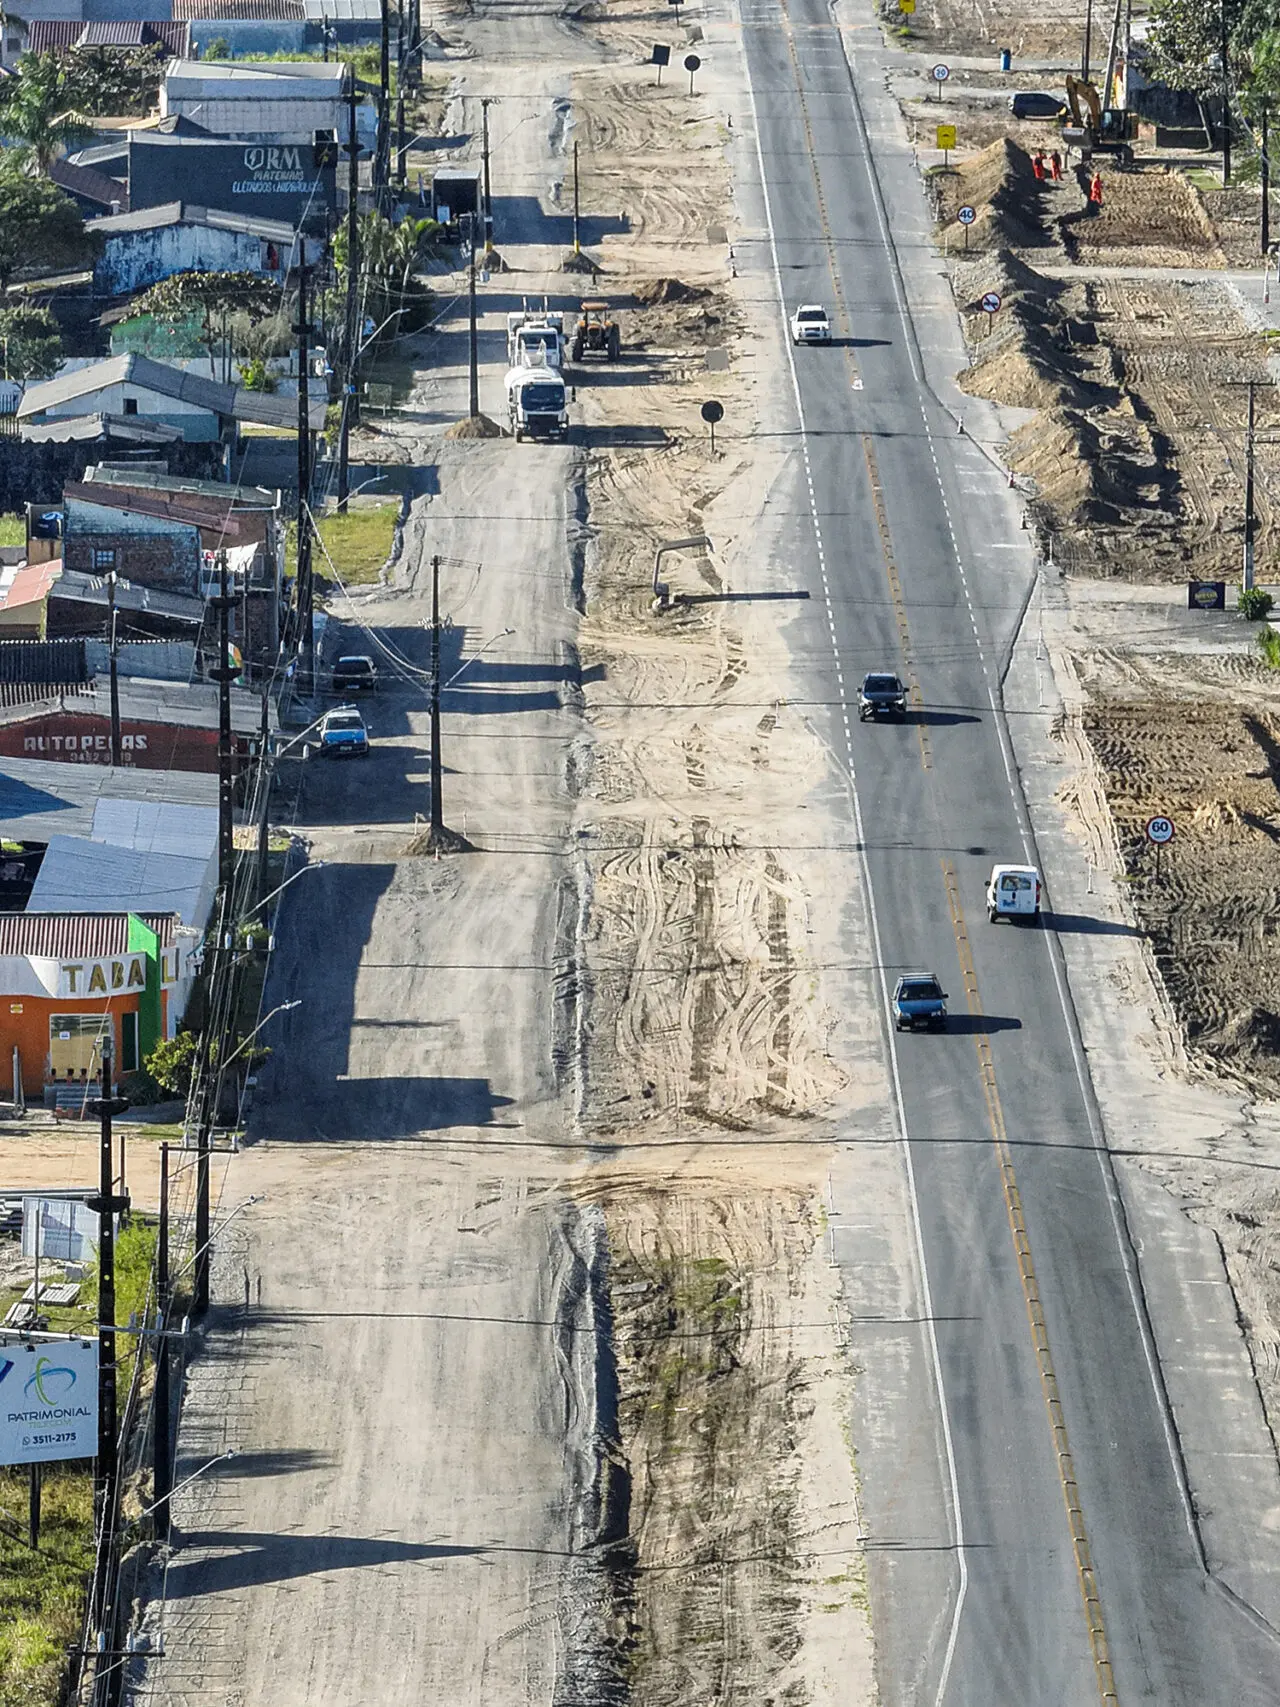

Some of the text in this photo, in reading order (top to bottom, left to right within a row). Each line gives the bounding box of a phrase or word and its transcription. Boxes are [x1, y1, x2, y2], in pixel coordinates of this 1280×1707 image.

[960, 209, 974, 219] 40
[1151, 821, 1169, 832] 60
[8, 1407, 91, 1422] PATRIMONIAL
[33, 1432, 77, 1445] 3511-2175
